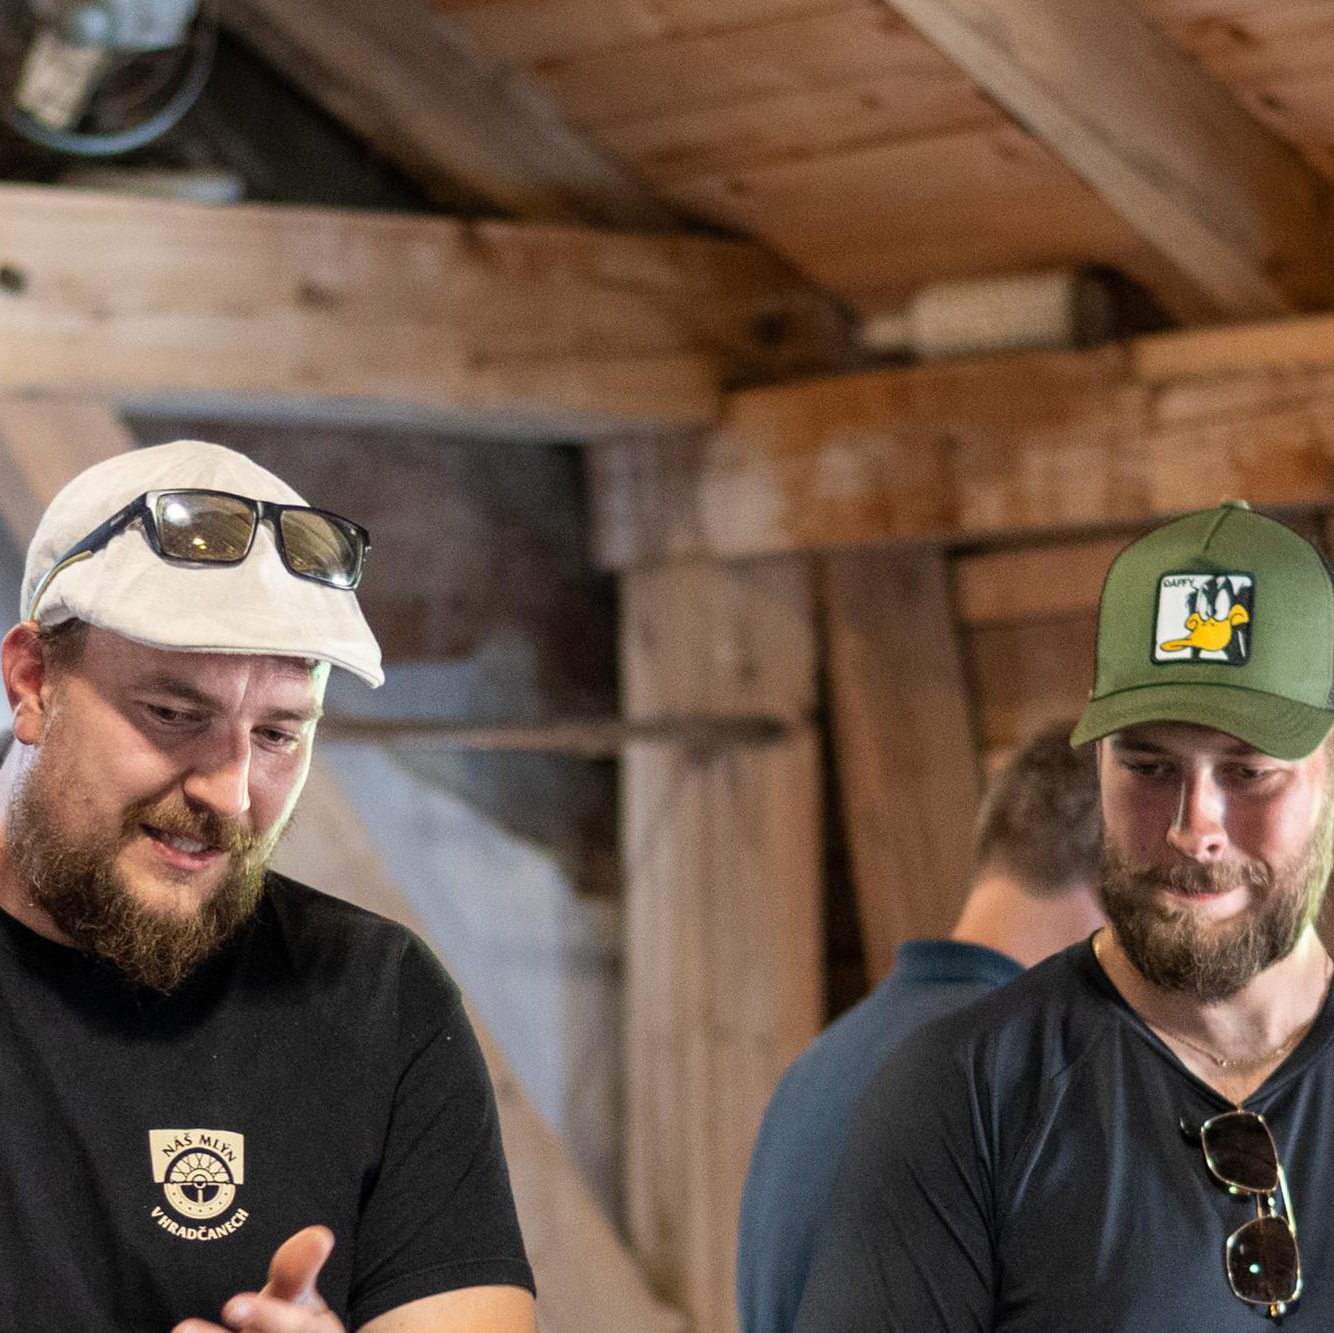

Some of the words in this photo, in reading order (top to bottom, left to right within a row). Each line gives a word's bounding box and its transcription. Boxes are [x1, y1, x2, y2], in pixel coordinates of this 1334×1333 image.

[1163, 578, 1194, 588] DAFFY
[162, 1133, 193, 1157] NÁŠ
[199, 1134, 237, 1162] MLÝN
[151, 1206, 164, 1217] V
[157, 1208, 249, 1241] HRADČANECH
